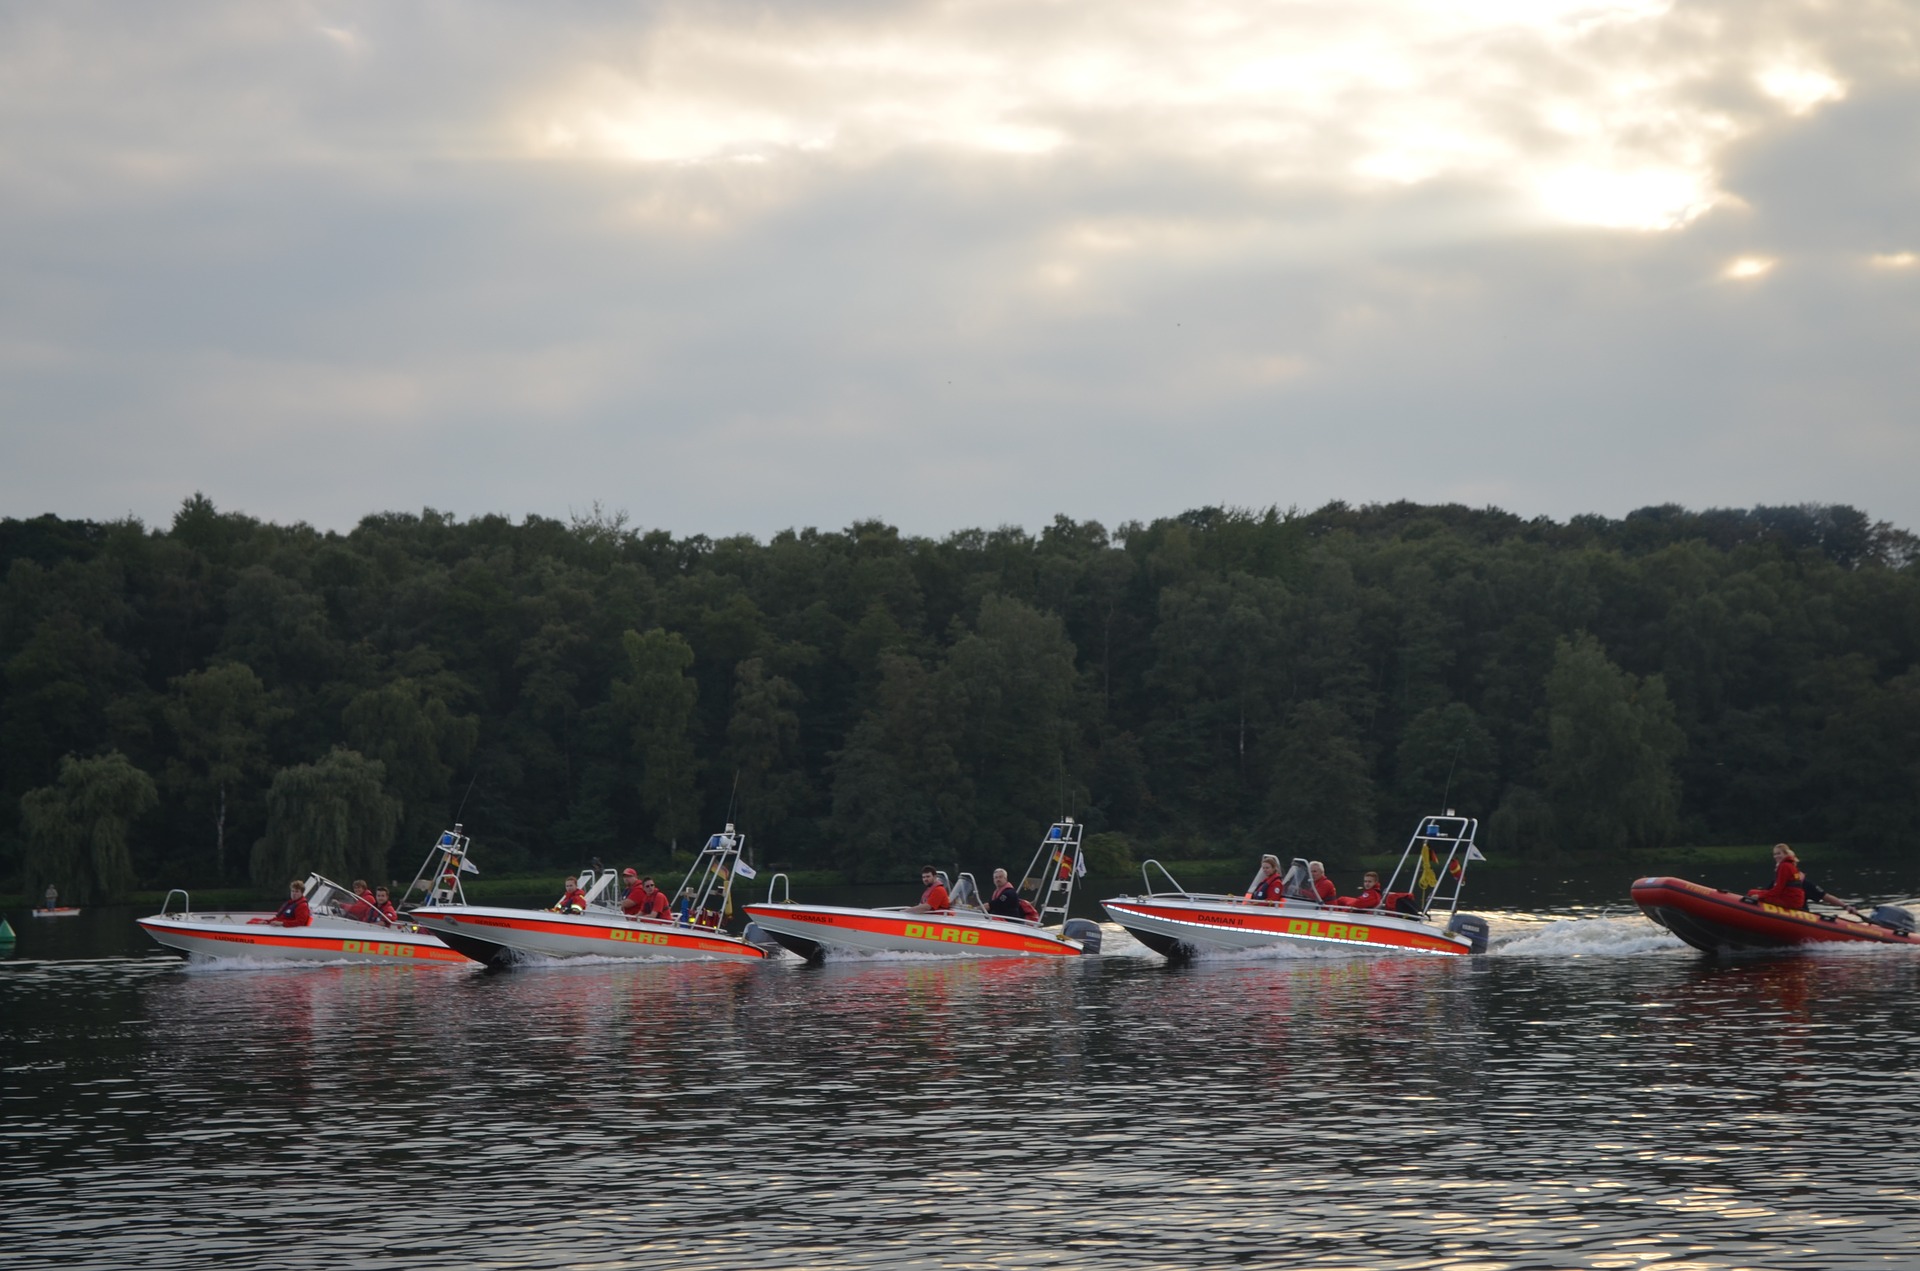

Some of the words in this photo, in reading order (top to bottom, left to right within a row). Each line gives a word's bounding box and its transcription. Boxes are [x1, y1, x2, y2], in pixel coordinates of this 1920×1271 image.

[791, 914, 826, 923] COSMAS
[1197, 915, 1235, 924] DAMIAN
[610, 929, 668, 945] DLRG
[904, 924, 980, 944] DLRG
[1288, 920, 1369, 941] DLRG
[342, 940, 416, 957] DLRG
